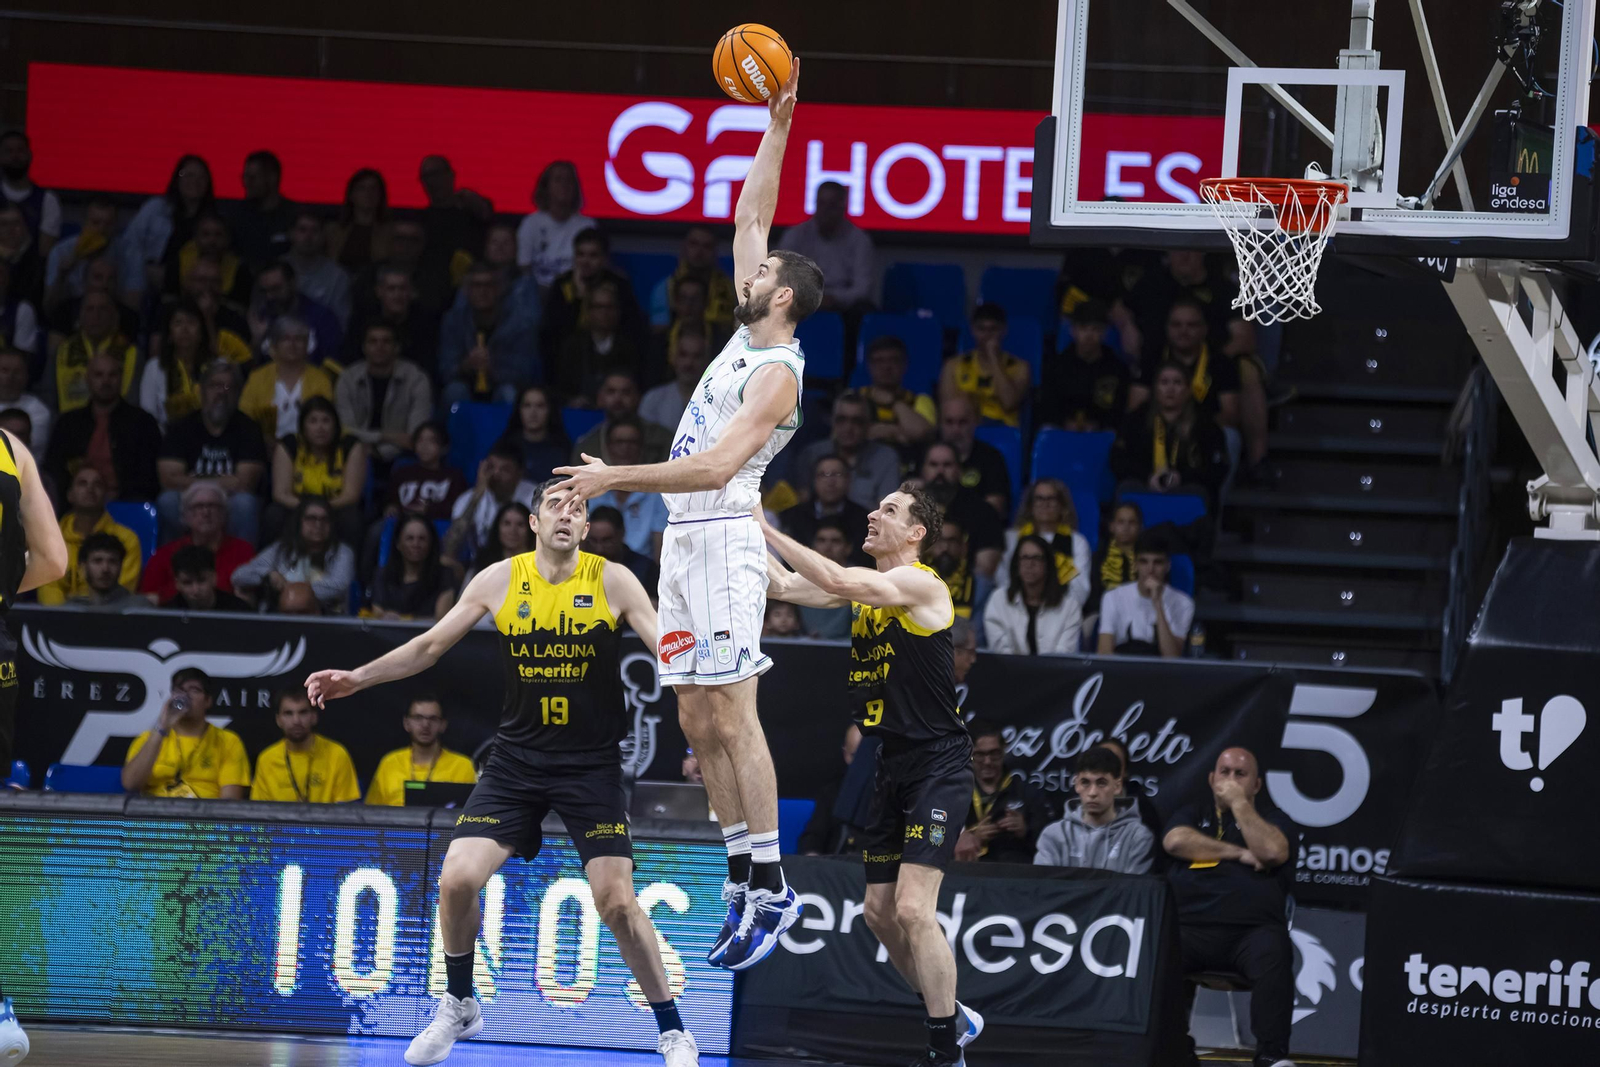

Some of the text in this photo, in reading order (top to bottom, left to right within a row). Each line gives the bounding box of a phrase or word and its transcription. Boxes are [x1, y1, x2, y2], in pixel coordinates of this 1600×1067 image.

[741, 54, 771, 99] Wilson
[803, 140, 1203, 223] HOTEES
[1491, 183, 1517, 198] liga
[1491, 196, 1546, 210] endesa
[510, 643, 596, 658] LA LAGUNA
[539, 696, 569, 726] 19
[863, 699, 884, 727] 9
[1265, 683, 1378, 828] 5
[463, 814, 501, 825] Hospiten
[1407, 998, 1501, 1021] despierta
